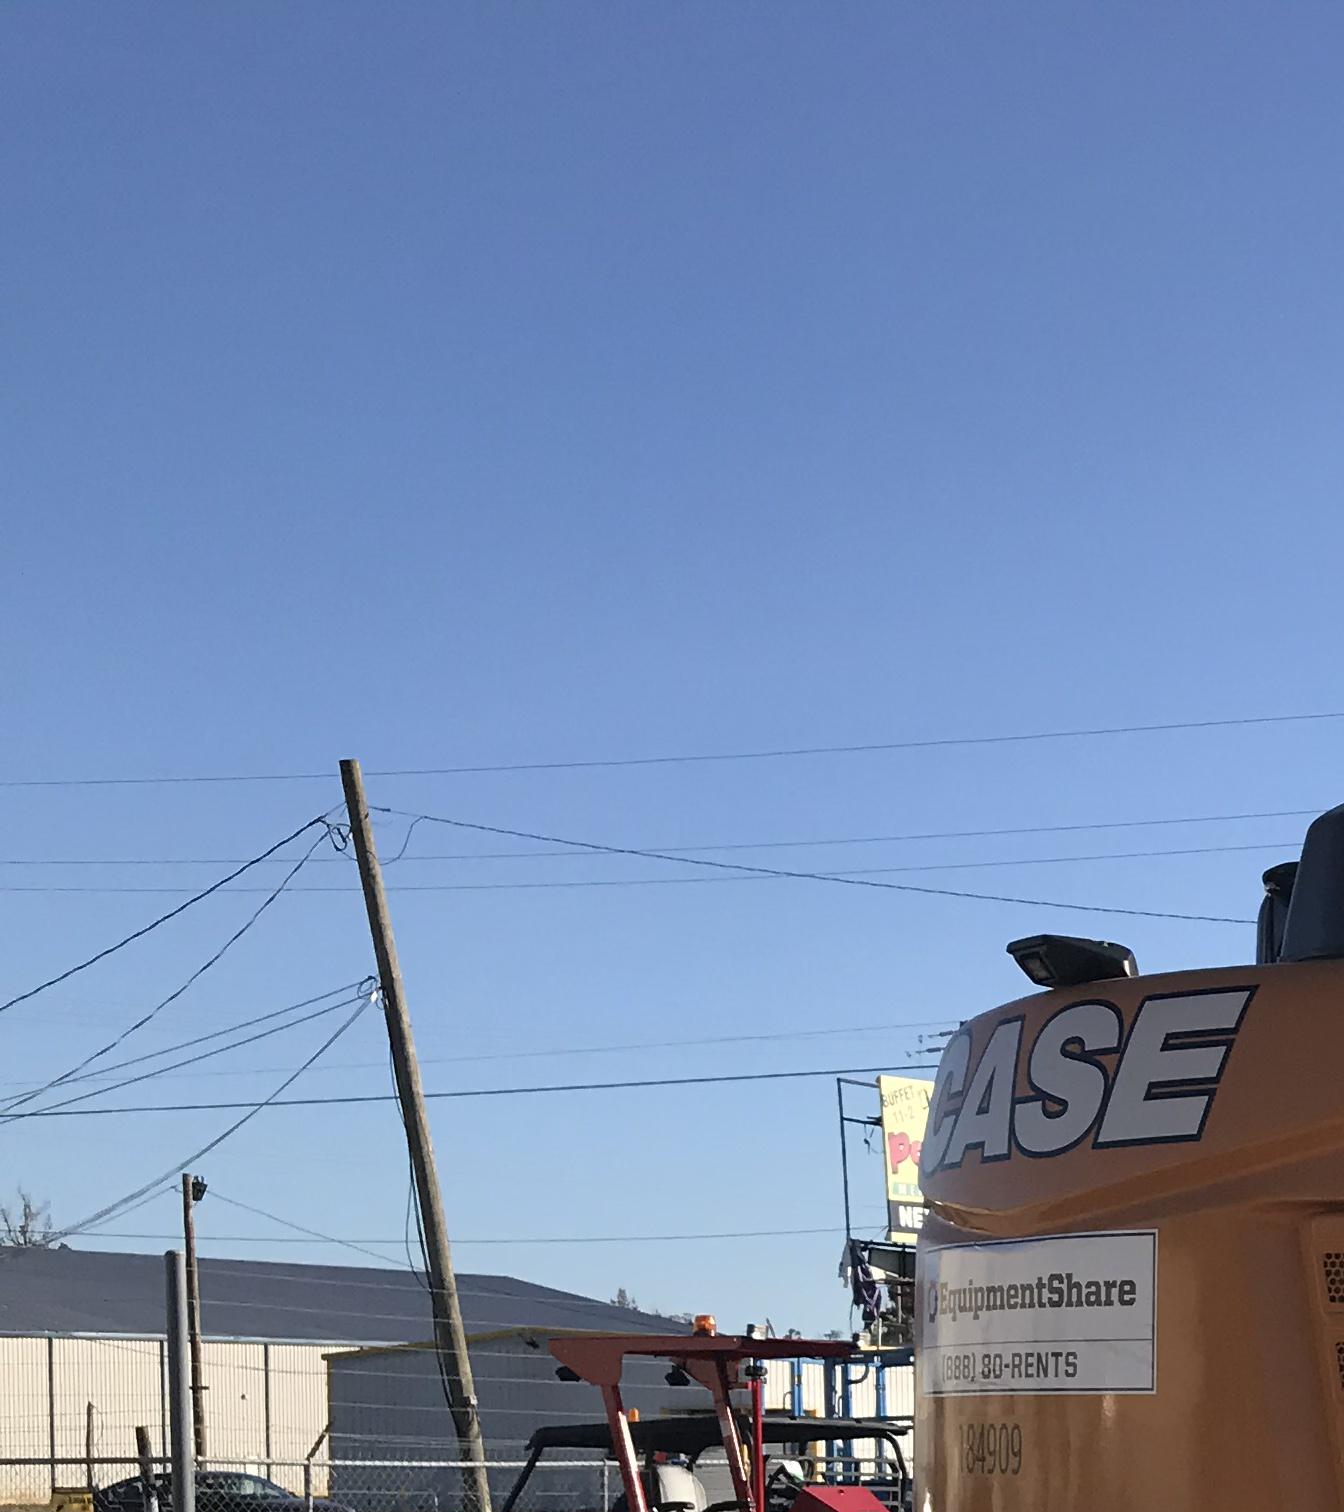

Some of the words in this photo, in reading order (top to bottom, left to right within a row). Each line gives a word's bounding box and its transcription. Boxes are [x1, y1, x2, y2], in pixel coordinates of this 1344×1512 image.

[883, 1085, 915, 1108] BUFFET
[921, 985, 1260, 1178] CASE
[939, 1272, 1137, 1322] EquipmentShare
[943, 1352, 977, 1383] (888)
[980, 1351, 1078, 1380] 80-RENTS
[959, 1423, 1022, 1475] 184909
